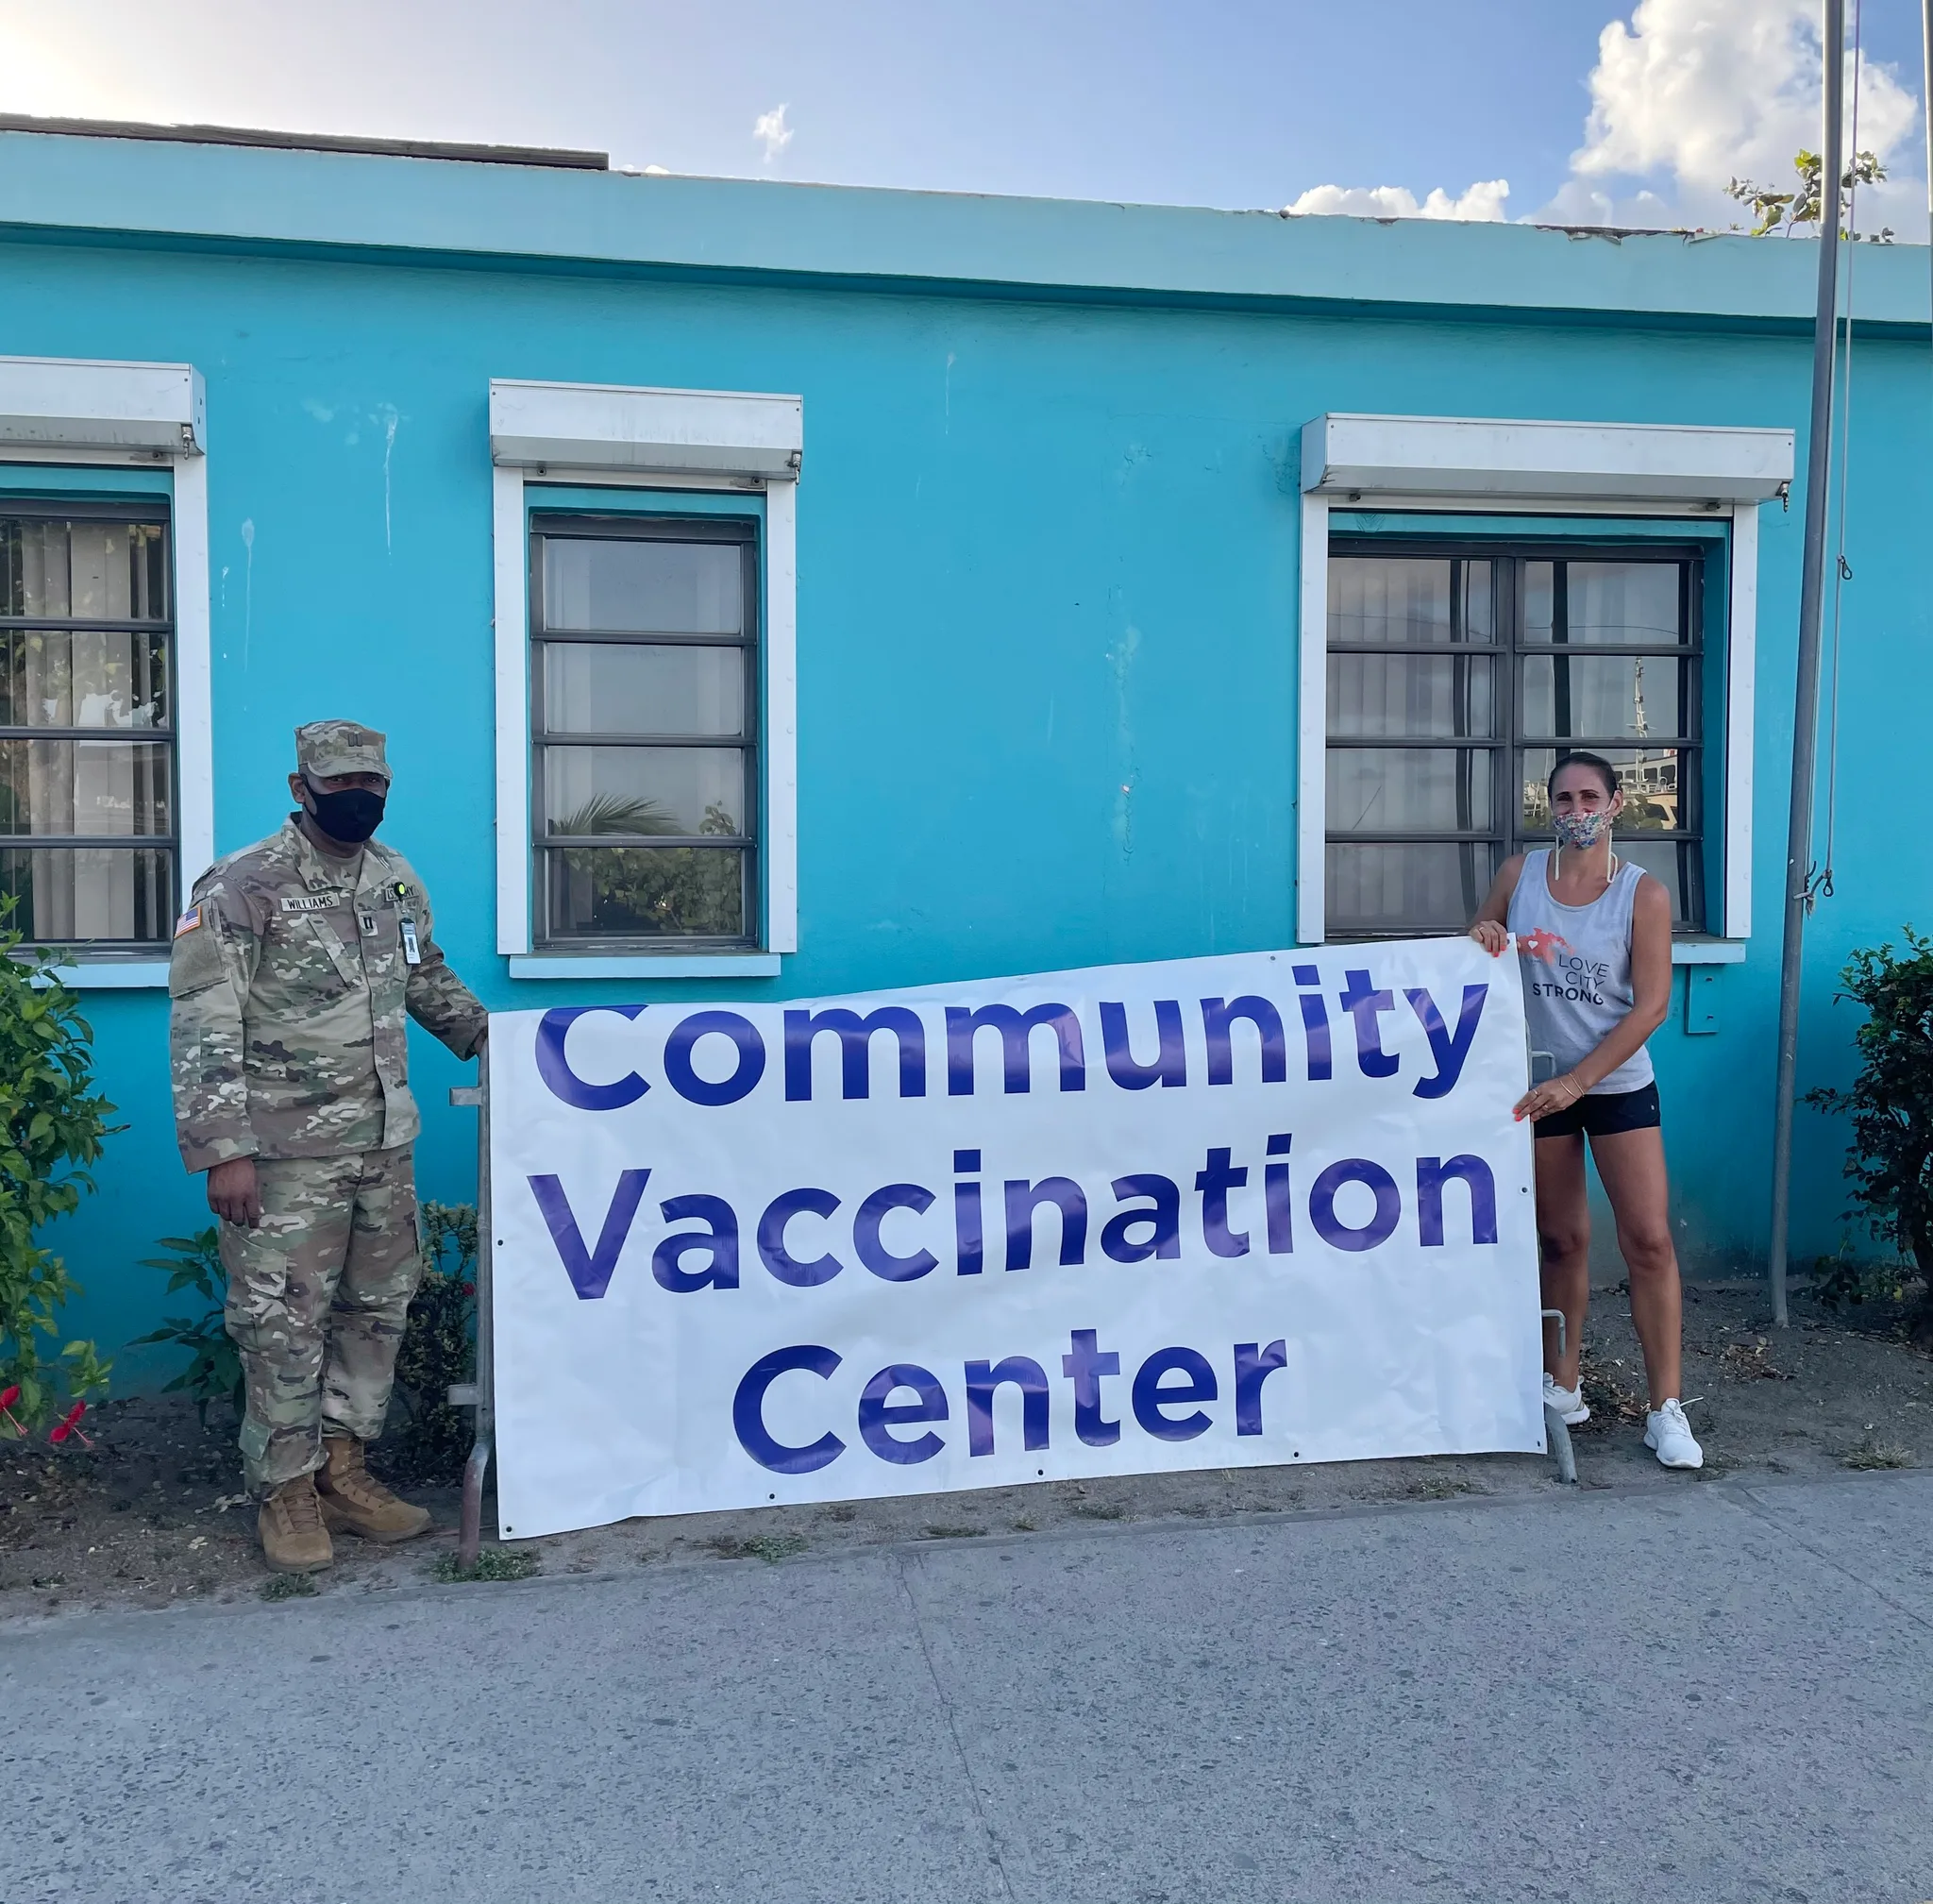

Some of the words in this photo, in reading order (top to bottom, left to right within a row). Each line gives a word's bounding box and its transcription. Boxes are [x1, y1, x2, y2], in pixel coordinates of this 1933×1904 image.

[286, 896, 333, 910] WILLIAMS
[1558, 953, 1610, 978] LOVE
[1565, 970, 1605, 990] CITY
[1532, 982, 1605, 1006] STRONG
[534, 964, 1489, 1112] Community
[526, 1133, 1499, 1302] Vaccination
[732, 1328, 1288, 1476] Center
